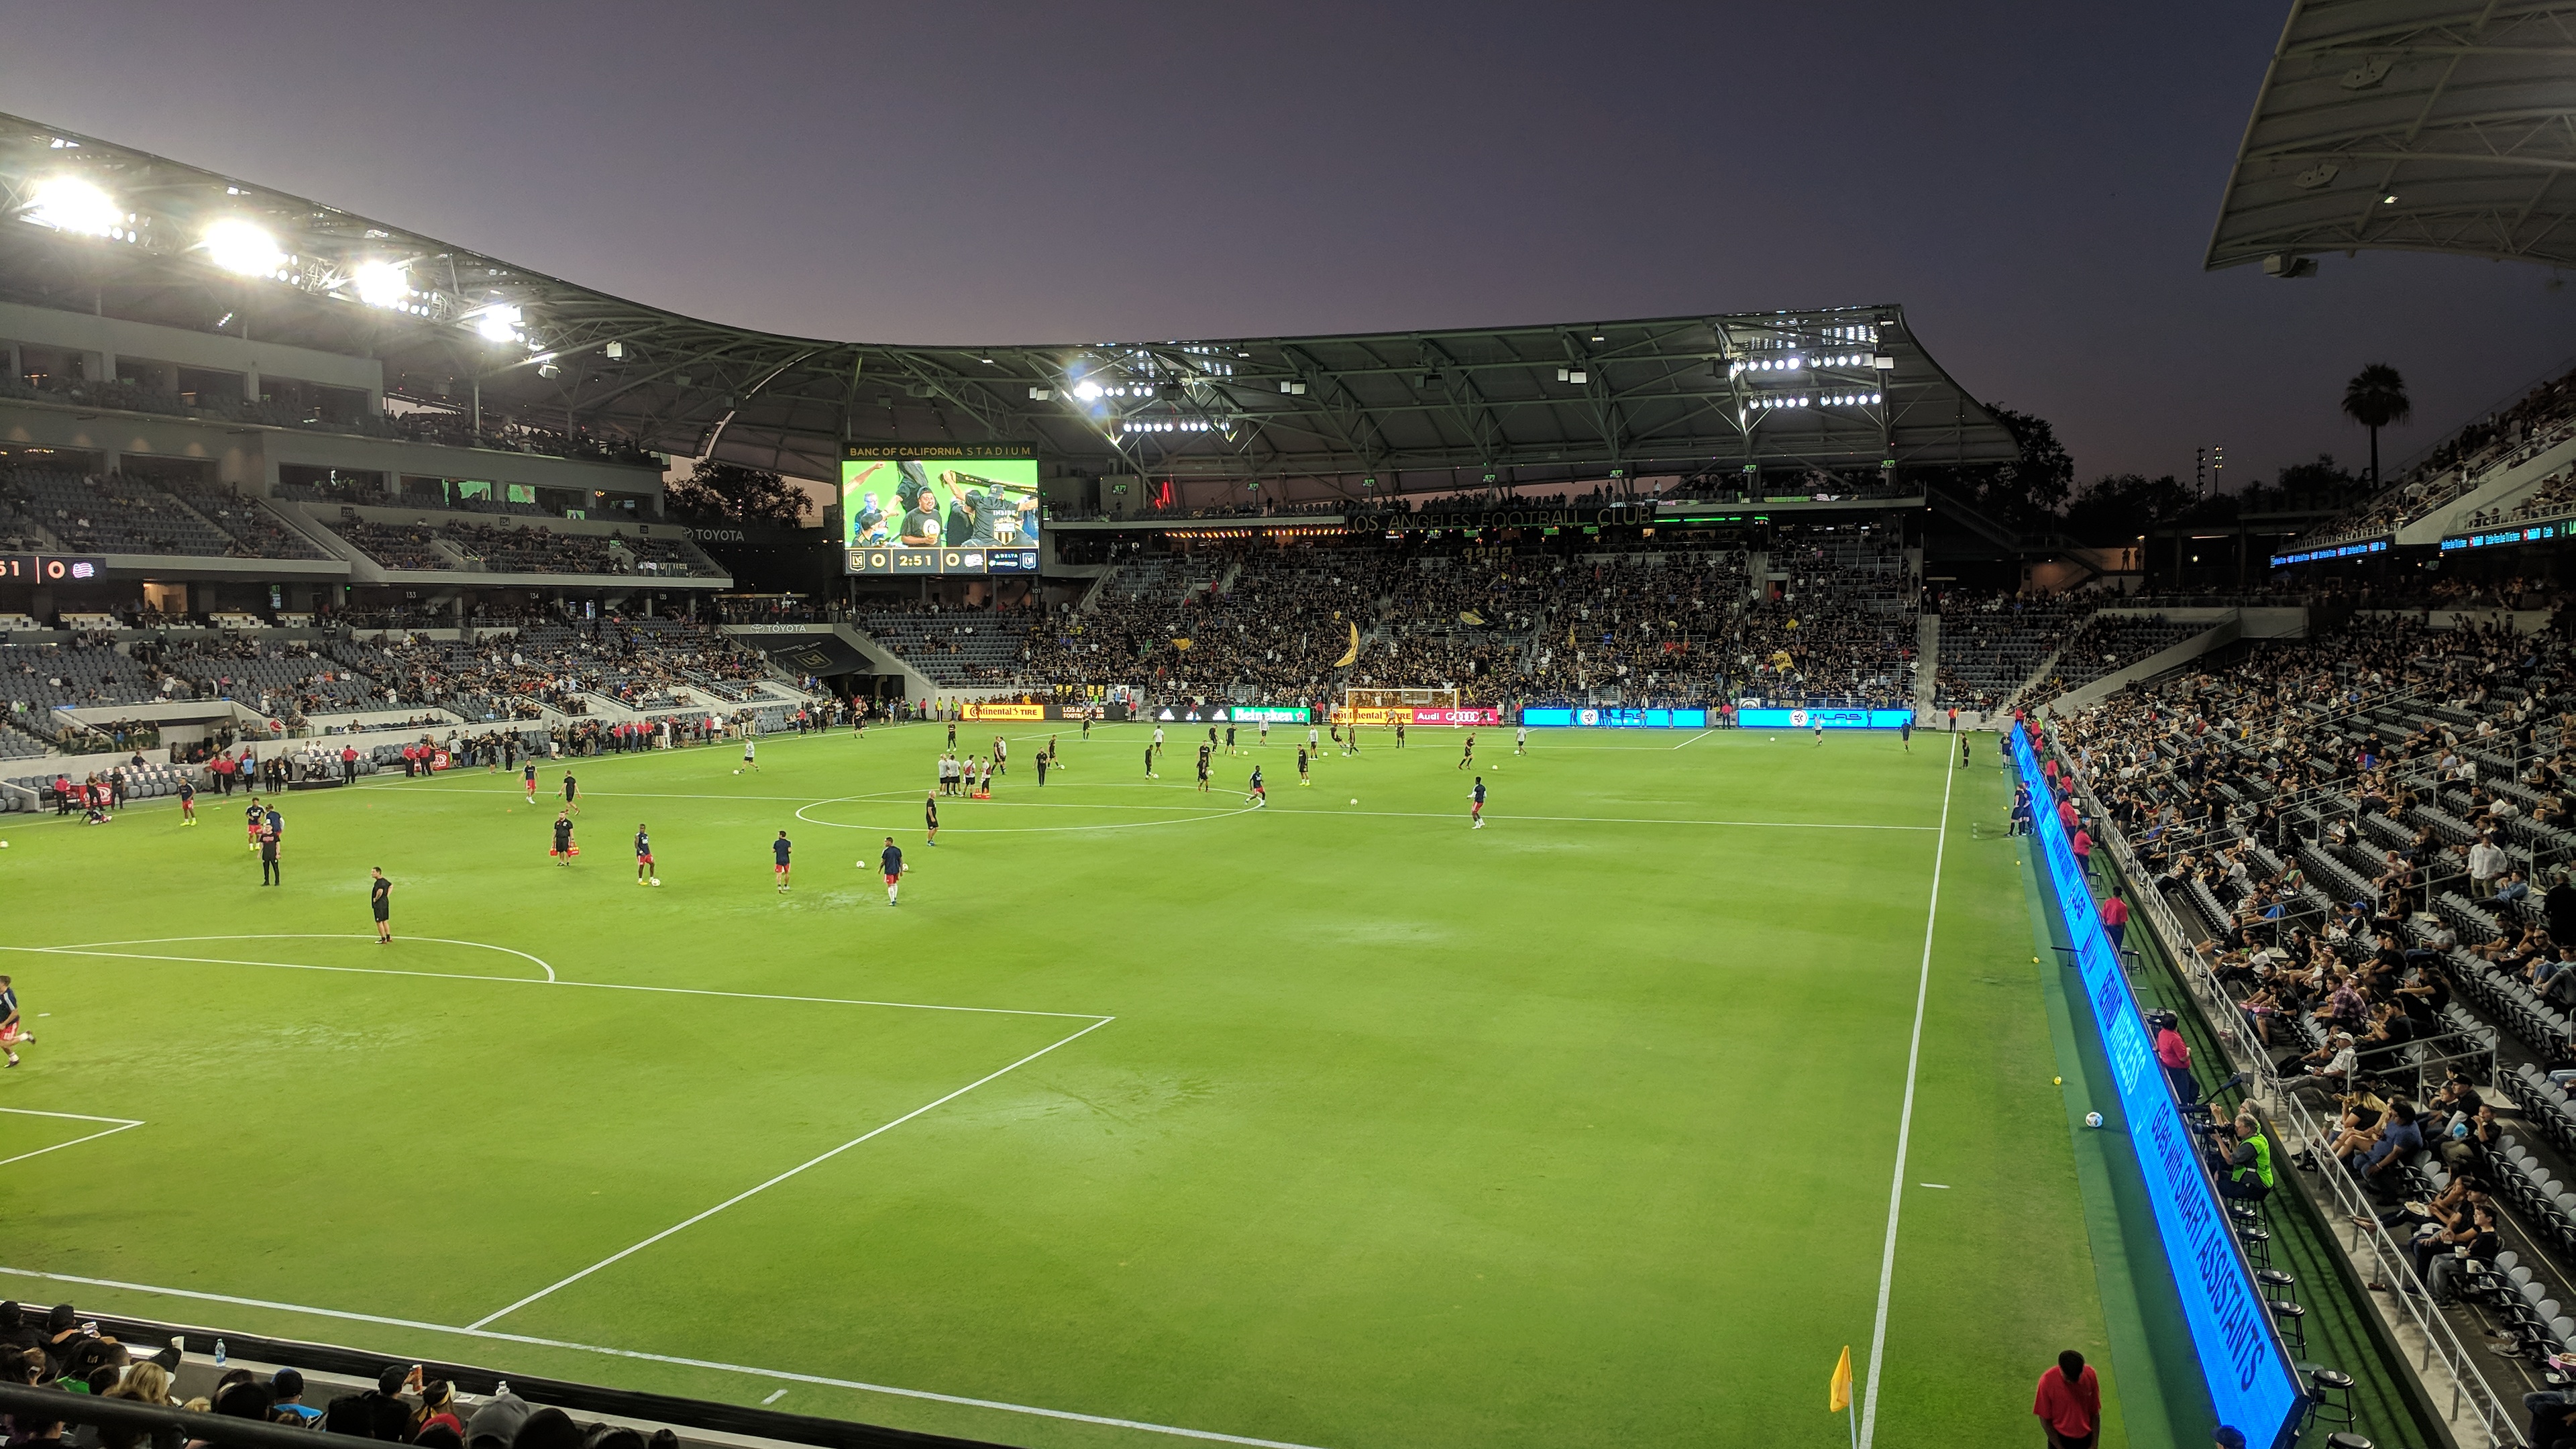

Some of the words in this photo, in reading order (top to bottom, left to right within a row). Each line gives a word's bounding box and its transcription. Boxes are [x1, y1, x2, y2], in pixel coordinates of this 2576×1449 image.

[850, 447, 879, 456] BANC
[882, 447, 897, 456] OF
[899, 447, 962, 456] CALIFORNIA
[967, 447, 1030, 456] STADIUM
[1345, 515, 1379, 534] LOS
[1388, 514, 1471, 530] ANGELES
[1480, 510, 1583, 529] FOOTBALL
[1597, 506, 1651, 526] CLUB
[695, 529, 745, 541] TOYOTA
[871, 553, 886, 568] 0
[899, 555, 932, 567] 2:51
[946, 553, 961, 567] 0
[47, 561, 66, 579] 0
[405, 591, 417, 599] 133
[529, 592, 539, 600] 134
[766, 625, 806, 633] TOYOTA
[1234, 708, 1293, 722] Heineken
[1417, 712, 1439, 720] Audi
[2109, 1003, 2147, 1096] WIRELESS
[2163, 1140, 2186, 1190] with
[2175, 1164, 2211, 1249] SMART
[2196, 1226, 2265, 1392] ASSISTANTS
